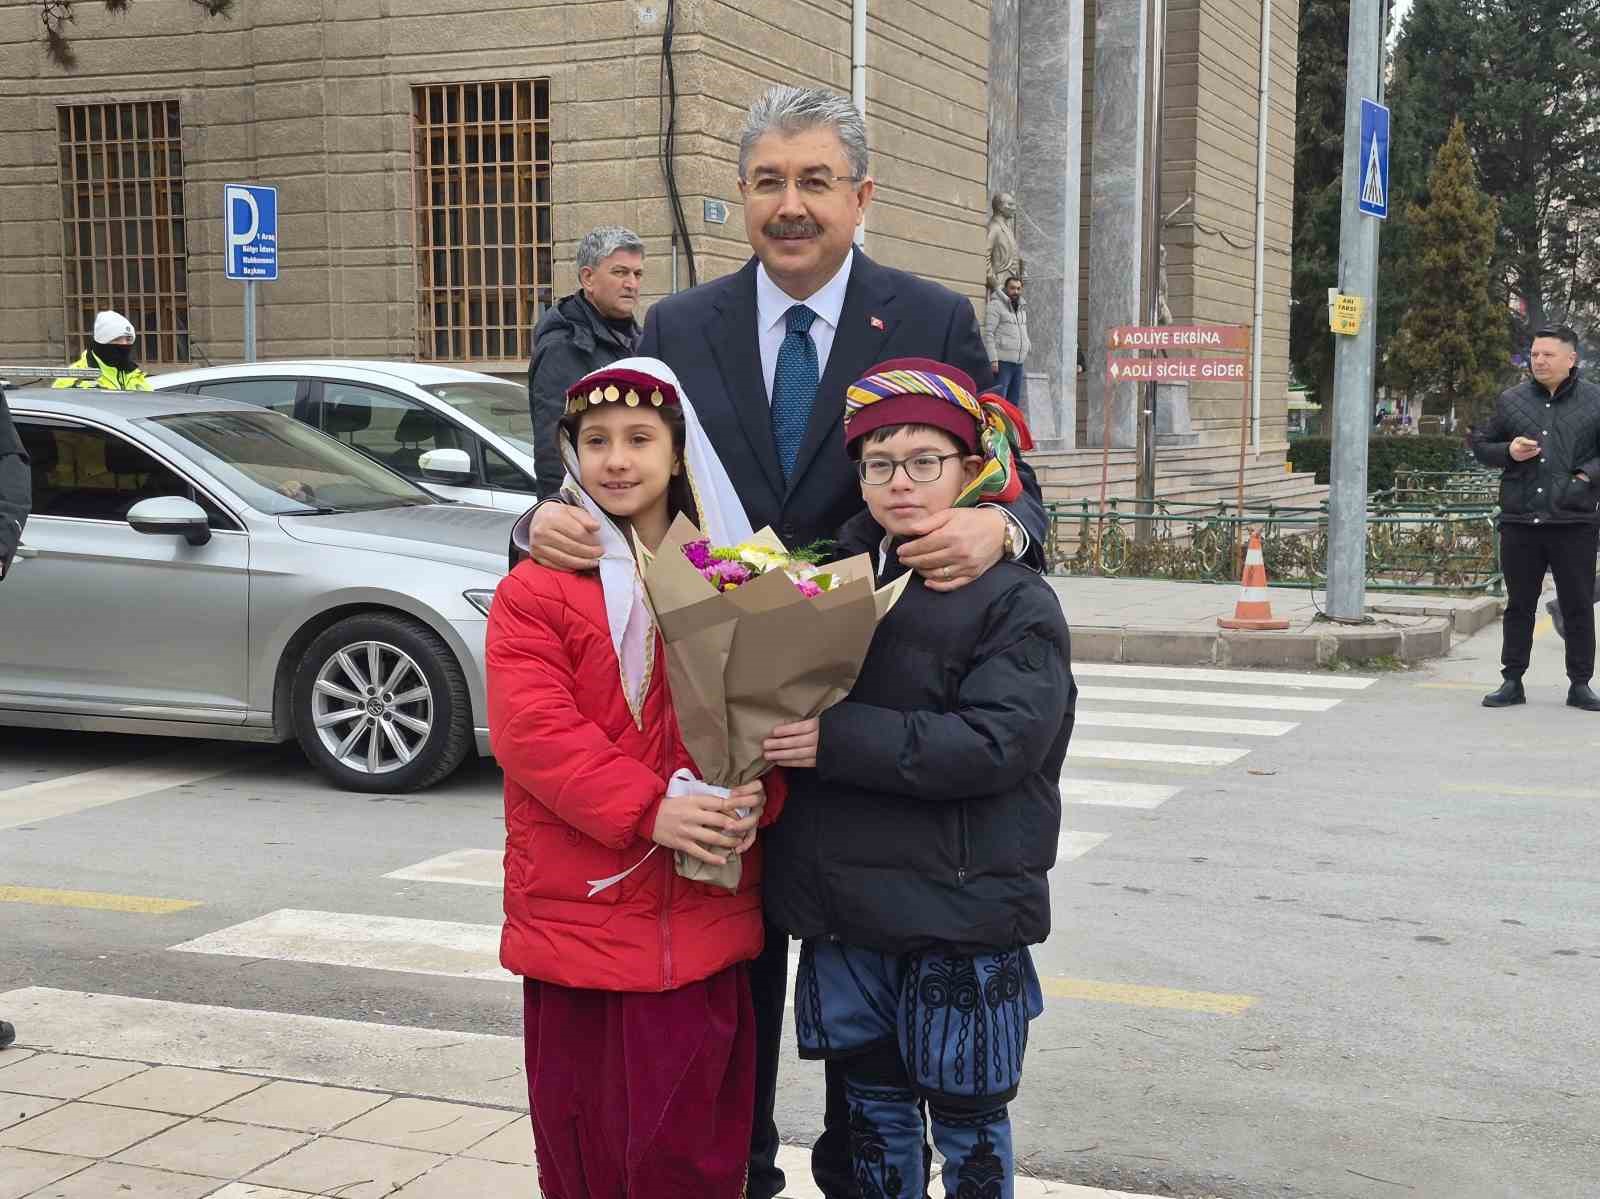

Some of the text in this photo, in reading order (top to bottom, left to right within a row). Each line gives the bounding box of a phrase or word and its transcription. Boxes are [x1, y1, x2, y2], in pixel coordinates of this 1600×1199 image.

[227, 188, 259, 273] P
[1123, 328, 1221, 344] ADLİYE EKBİNA
[1121, 361, 1244, 377] ADLİ SİCİLE GİDER
